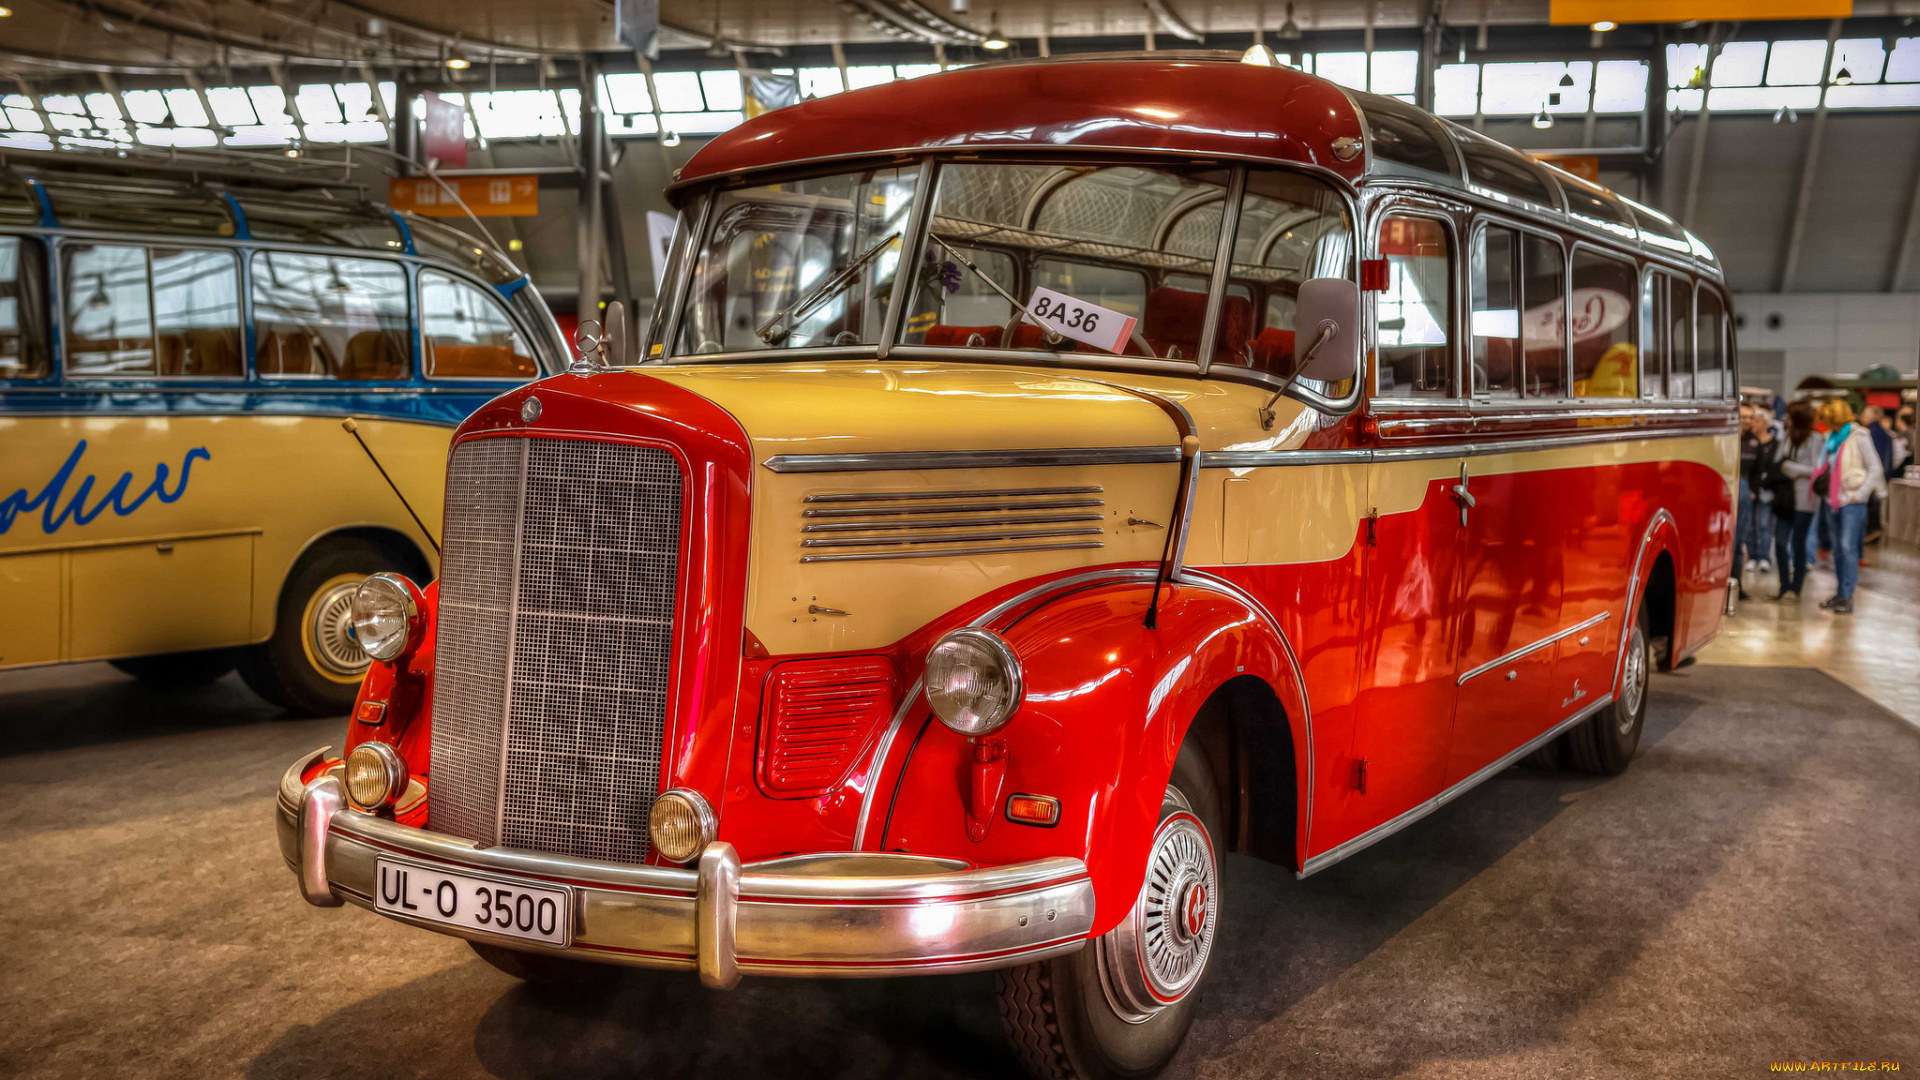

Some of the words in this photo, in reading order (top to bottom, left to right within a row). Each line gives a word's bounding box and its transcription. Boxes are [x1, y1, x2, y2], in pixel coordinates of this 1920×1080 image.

[1034, 297, 1100, 333] 8A36
[381, 866, 458, 918] UL-O
[474, 886, 557, 936] 3500
